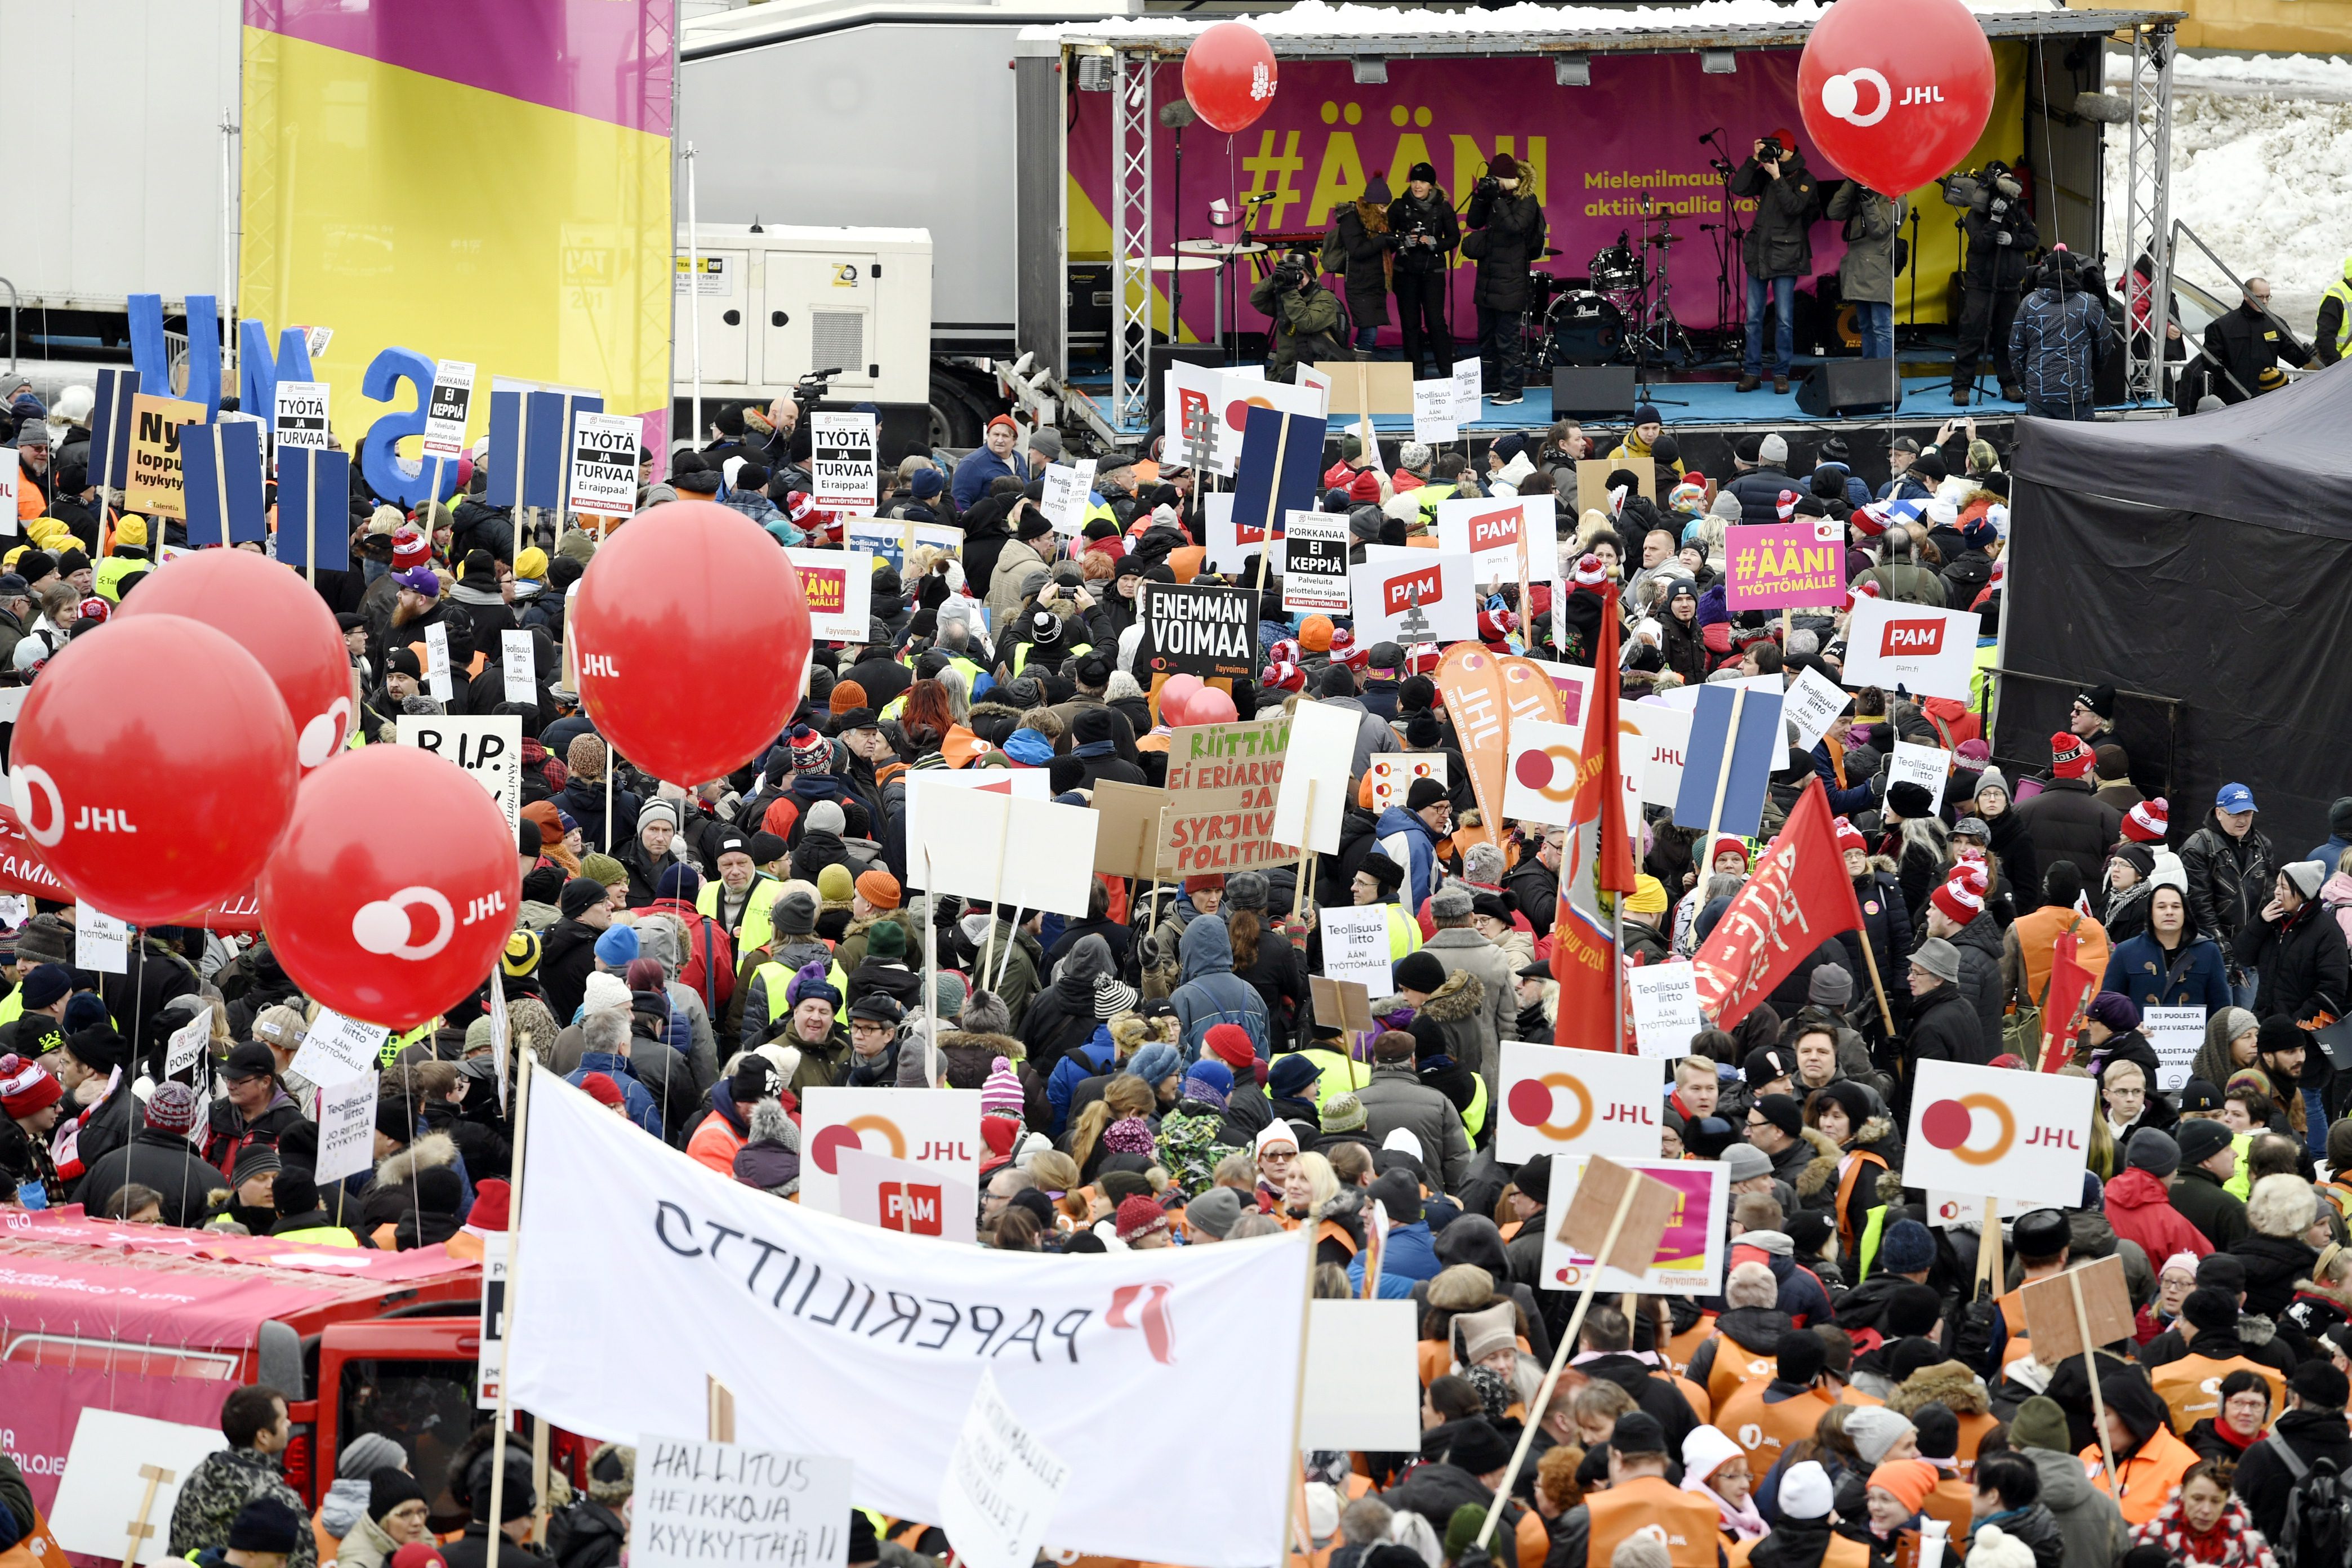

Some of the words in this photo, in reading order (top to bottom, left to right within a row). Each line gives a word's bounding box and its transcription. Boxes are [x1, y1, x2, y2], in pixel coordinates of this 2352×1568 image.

[1899, 86, 1944, 105] JHL
[1584, 195, 1721, 216] aktiivimallia
[1573, 304, 1600, 317] Pearl
[437, 375, 470, 387] PORKKANAA
[1456, 371, 1478, 381] Teollisuus
[1464, 378, 1476, 387] liitto
[444, 389, 455, 402] EI
[1415, 390, 1451, 400] Teollisuus
[1429, 397, 1446, 406] liitto
[1455, 393, 1480, 405] TYÖTTÖMÄLLE
[278, 397, 324, 416] TYÖTÄ
[432, 401, 465, 419] KEPPIÄ
[294, 418, 306, 429] JA
[434, 421, 456, 431] Palveluita
[1416, 415, 1454, 424] TYÖTTÖMÄLLE
[139, 412, 197, 453] Ny
[277, 430, 324, 446] TURVAA
[426, 431, 447, 440] pelottelun
[447, 433, 461, 443] sijaan
[816, 428, 871, 447] TYÖTÄ
[579, 430, 635, 451] TYÖTÄ
[599, 451, 611, 462] JA
[838, 449, 849, 460] JA
[576, 464, 634, 483] TURVAA
[816, 462, 874, 478] TURVAA
[579, 481, 587, 491] Ei
[589, 483, 629, 495] raippaa!
[822, 480, 830, 489] Ei
[831, 480, 868, 491] raippaa!
[152, 501, 179, 512] Talentia
[573, 498, 630, 511] #ÄÄNITYÖTTÖMÄLLE
[819, 497, 871, 506] #ÄÄNITYÖTTÖMÄLLE
[1289, 527, 1345, 540] PORKKANAA
[1476, 517, 1517, 541] PAM
[859, 545, 875, 554] liitto
[1309, 541, 1322, 555] EI
[1291, 554, 1342, 573] KEPPIÄ
[1487, 556, 1509, 565] pam.fi
[1736, 538, 1835, 581] #ÄÄNI
[1298, 575, 1333, 586] Palveluita
[1737, 574, 1837, 597] TYÖTTÖMÄLLE
[1286, 586, 1323, 598] pelottelun
[1324, 588, 1346, 599] sijaan
[1152, 591, 1248, 624] ENEMMÄN
[1288, 598, 1343, 609] #ÄÄNITYÖTTÖMÄLLE
[825, 626, 860, 637] #ayvoimaa
[1889, 628, 1936, 646] PAM
[429, 638, 446, 650] Teollisuus
[1151, 619, 1250, 660] VOIMAA
[505, 644, 531, 653] Teollisuus
[514, 653, 526, 663] liitto
[514, 666, 523, 674] ÄÄNI
[582, 653, 620, 678] JHL
[1215, 662, 1249, 675] #ayvoimaa
[1896, 663, 1919, 673] pam.fi
[506, 675, 533, 683] TYÖTTÖMÄLLE
[1799, 679, 1838, 713] Teollisuus
[1807, 697, 1827, 715] liitto
[1797, 707, 1813, 721] ÄÄNI
[1783, 707, 1821, 738] YÖTTÖMÄLLE
[1651, 746, 1685, 767] JHL
[1897, 756, 1943, 773] Teollisuus
[1912, 768, 1934, 780] liitto
[1241, 785, 1273, 809] JA
[74, 805, 137, 833] JHL
[462, 890, 506, 926] JHL
[93, 920, 109, 929] ÄÄNI
[1328, 923, 1382, 936] Teollisuus
[79, 930, 123, 942] TYÖTTÖMÄLLE
[1349, 934, 1374, 945] liitto
[1347, 950, 1367, 959] ÄÄNI
[1329, 959, 1387, 970] TYÖTTÖMÄLLE
[1637, 981, 1690, 995] Teollisuus
[1659, 992, 1683, 1003] liitto
[1658, 1009, 1677, 1018] ÄÄNI
[1640, 1017, 1696, 1031] TYÖTTÖMÄLLE
[341, 1024, 367, 1044] liitto
[331, 1037, 352, 1052] ÄÄNI
[309, 1037, 364, 1072] TYÖTTÖMÄLLE
[327, 1093, 372, 1115] Teollisuus
[343, 1106, 364, 1122] liitto
[1603, 1102, 1654, 1126] JHL
[326, 1130, 338, 1142] JO
[340, 1118, 370, 1136] RIITTÄÄ
[326, 1130, 368, 1152] KYYKYTYS
[2025, 1126, 2081, 1151] JHL
[916, 1142, 971, 1160] JHL
[888, 1195, 935, 1223] PAM
[1658, 1273, 1709, 1289] #ayvoimaa
[1763, 1436, 1781, 1448] JHL
[651, 1442, 812, 1493] HALLITUS
[649, 1489, 791, 1524] HEIKKOJA
[1668, 1535, 1687, 1546] JHL
